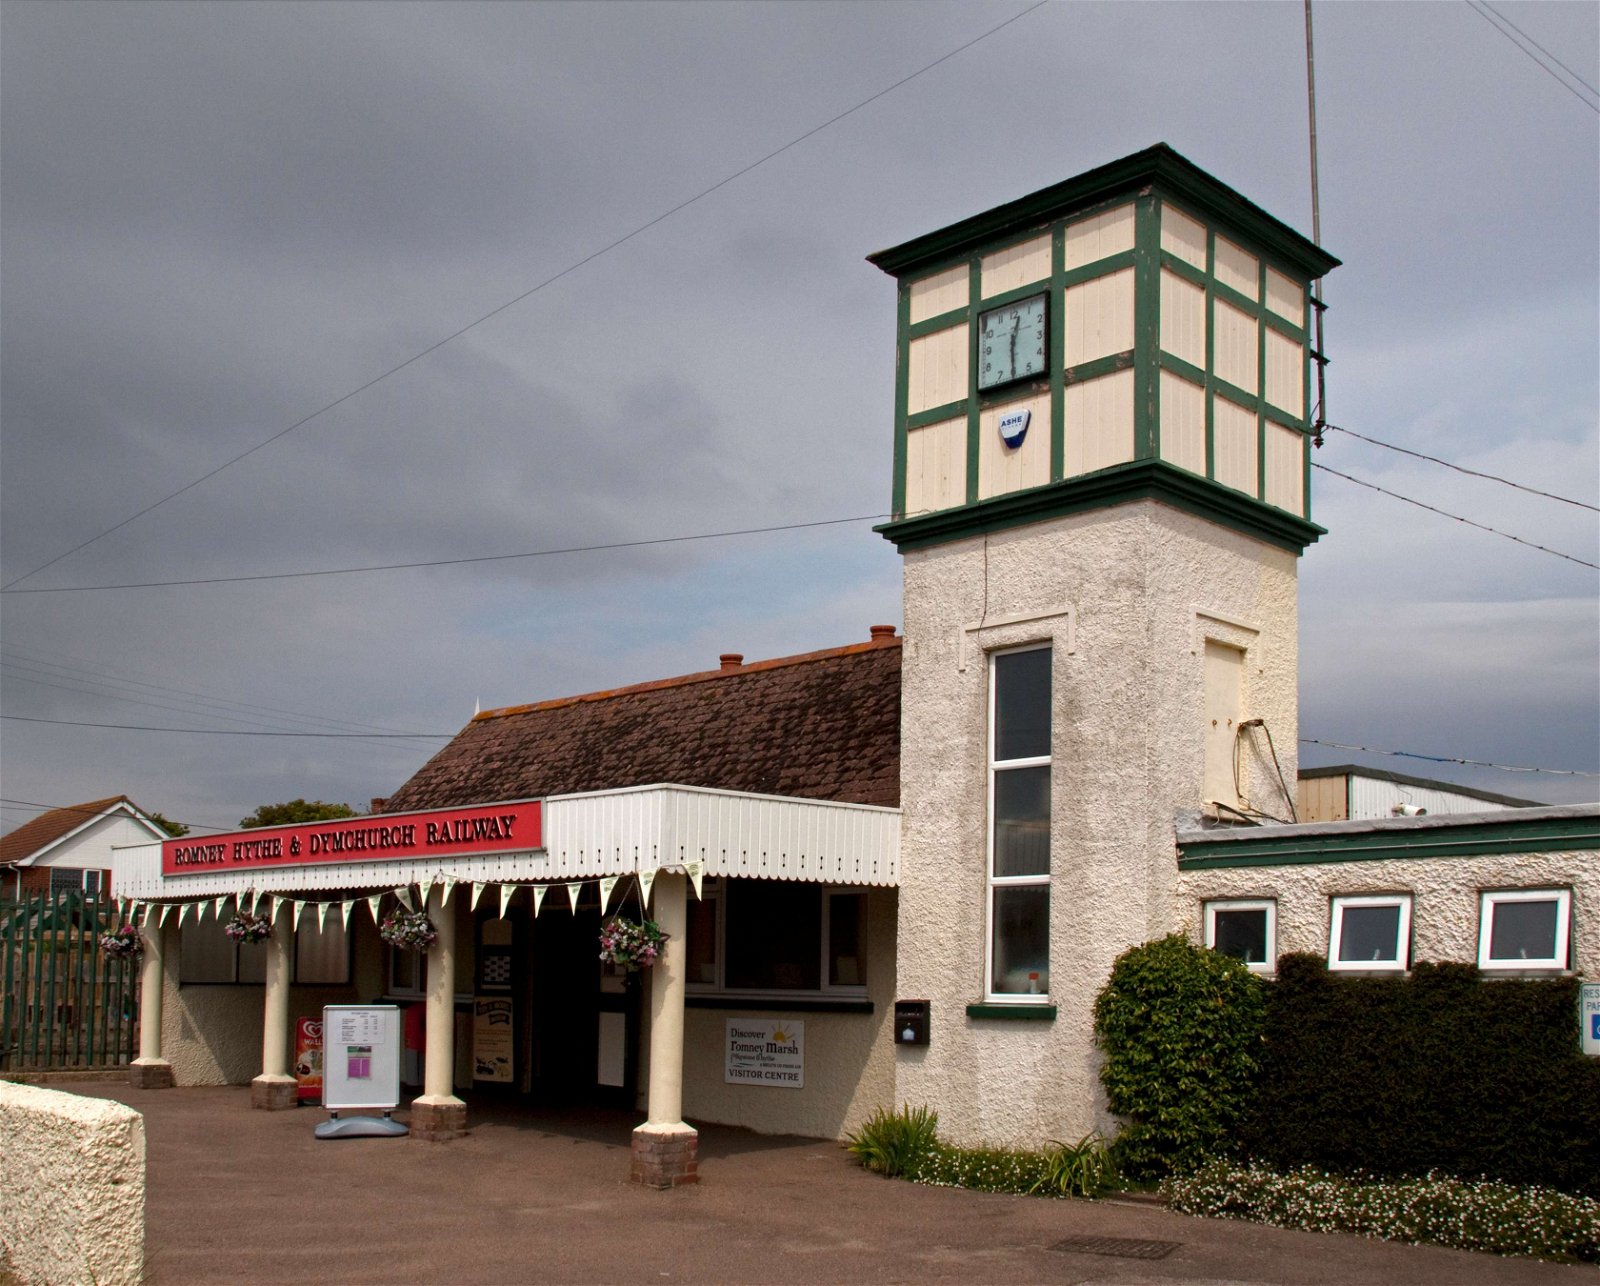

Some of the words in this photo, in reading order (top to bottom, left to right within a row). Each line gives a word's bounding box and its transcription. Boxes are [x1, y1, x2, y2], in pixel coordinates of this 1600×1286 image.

[998, 314, 1004, 325] 11
[1009, 311, 1018, 320] 12
[1037, 314, 1043, 323] 2
[986, 330, 993, 339] 10
[1037, 331, 1042, 340] 3
[986, 346, 992, 355] 9
[1037, 347, 1042, 356] 4
[986, 363, 991, 372] 8
[1026, 362, 1032, 371] 5
[998, 370, 1003, 380] 7
[1001, 416, 1022, 427] ASHE
[175, 844, 226, 865] ROMNEY
[233, 838, 283, 860] HYTHE
[290, 835, 302, 855] &
[310, 824, 416, 854] DYMCHURCH
[426, 814, 517, 844] RAILWAY
[730, 1028, 766, 1039] Discover
[729, 1068, 763, 1079] VISITOR
[764, 1071, 799, 1081] CENTRE
